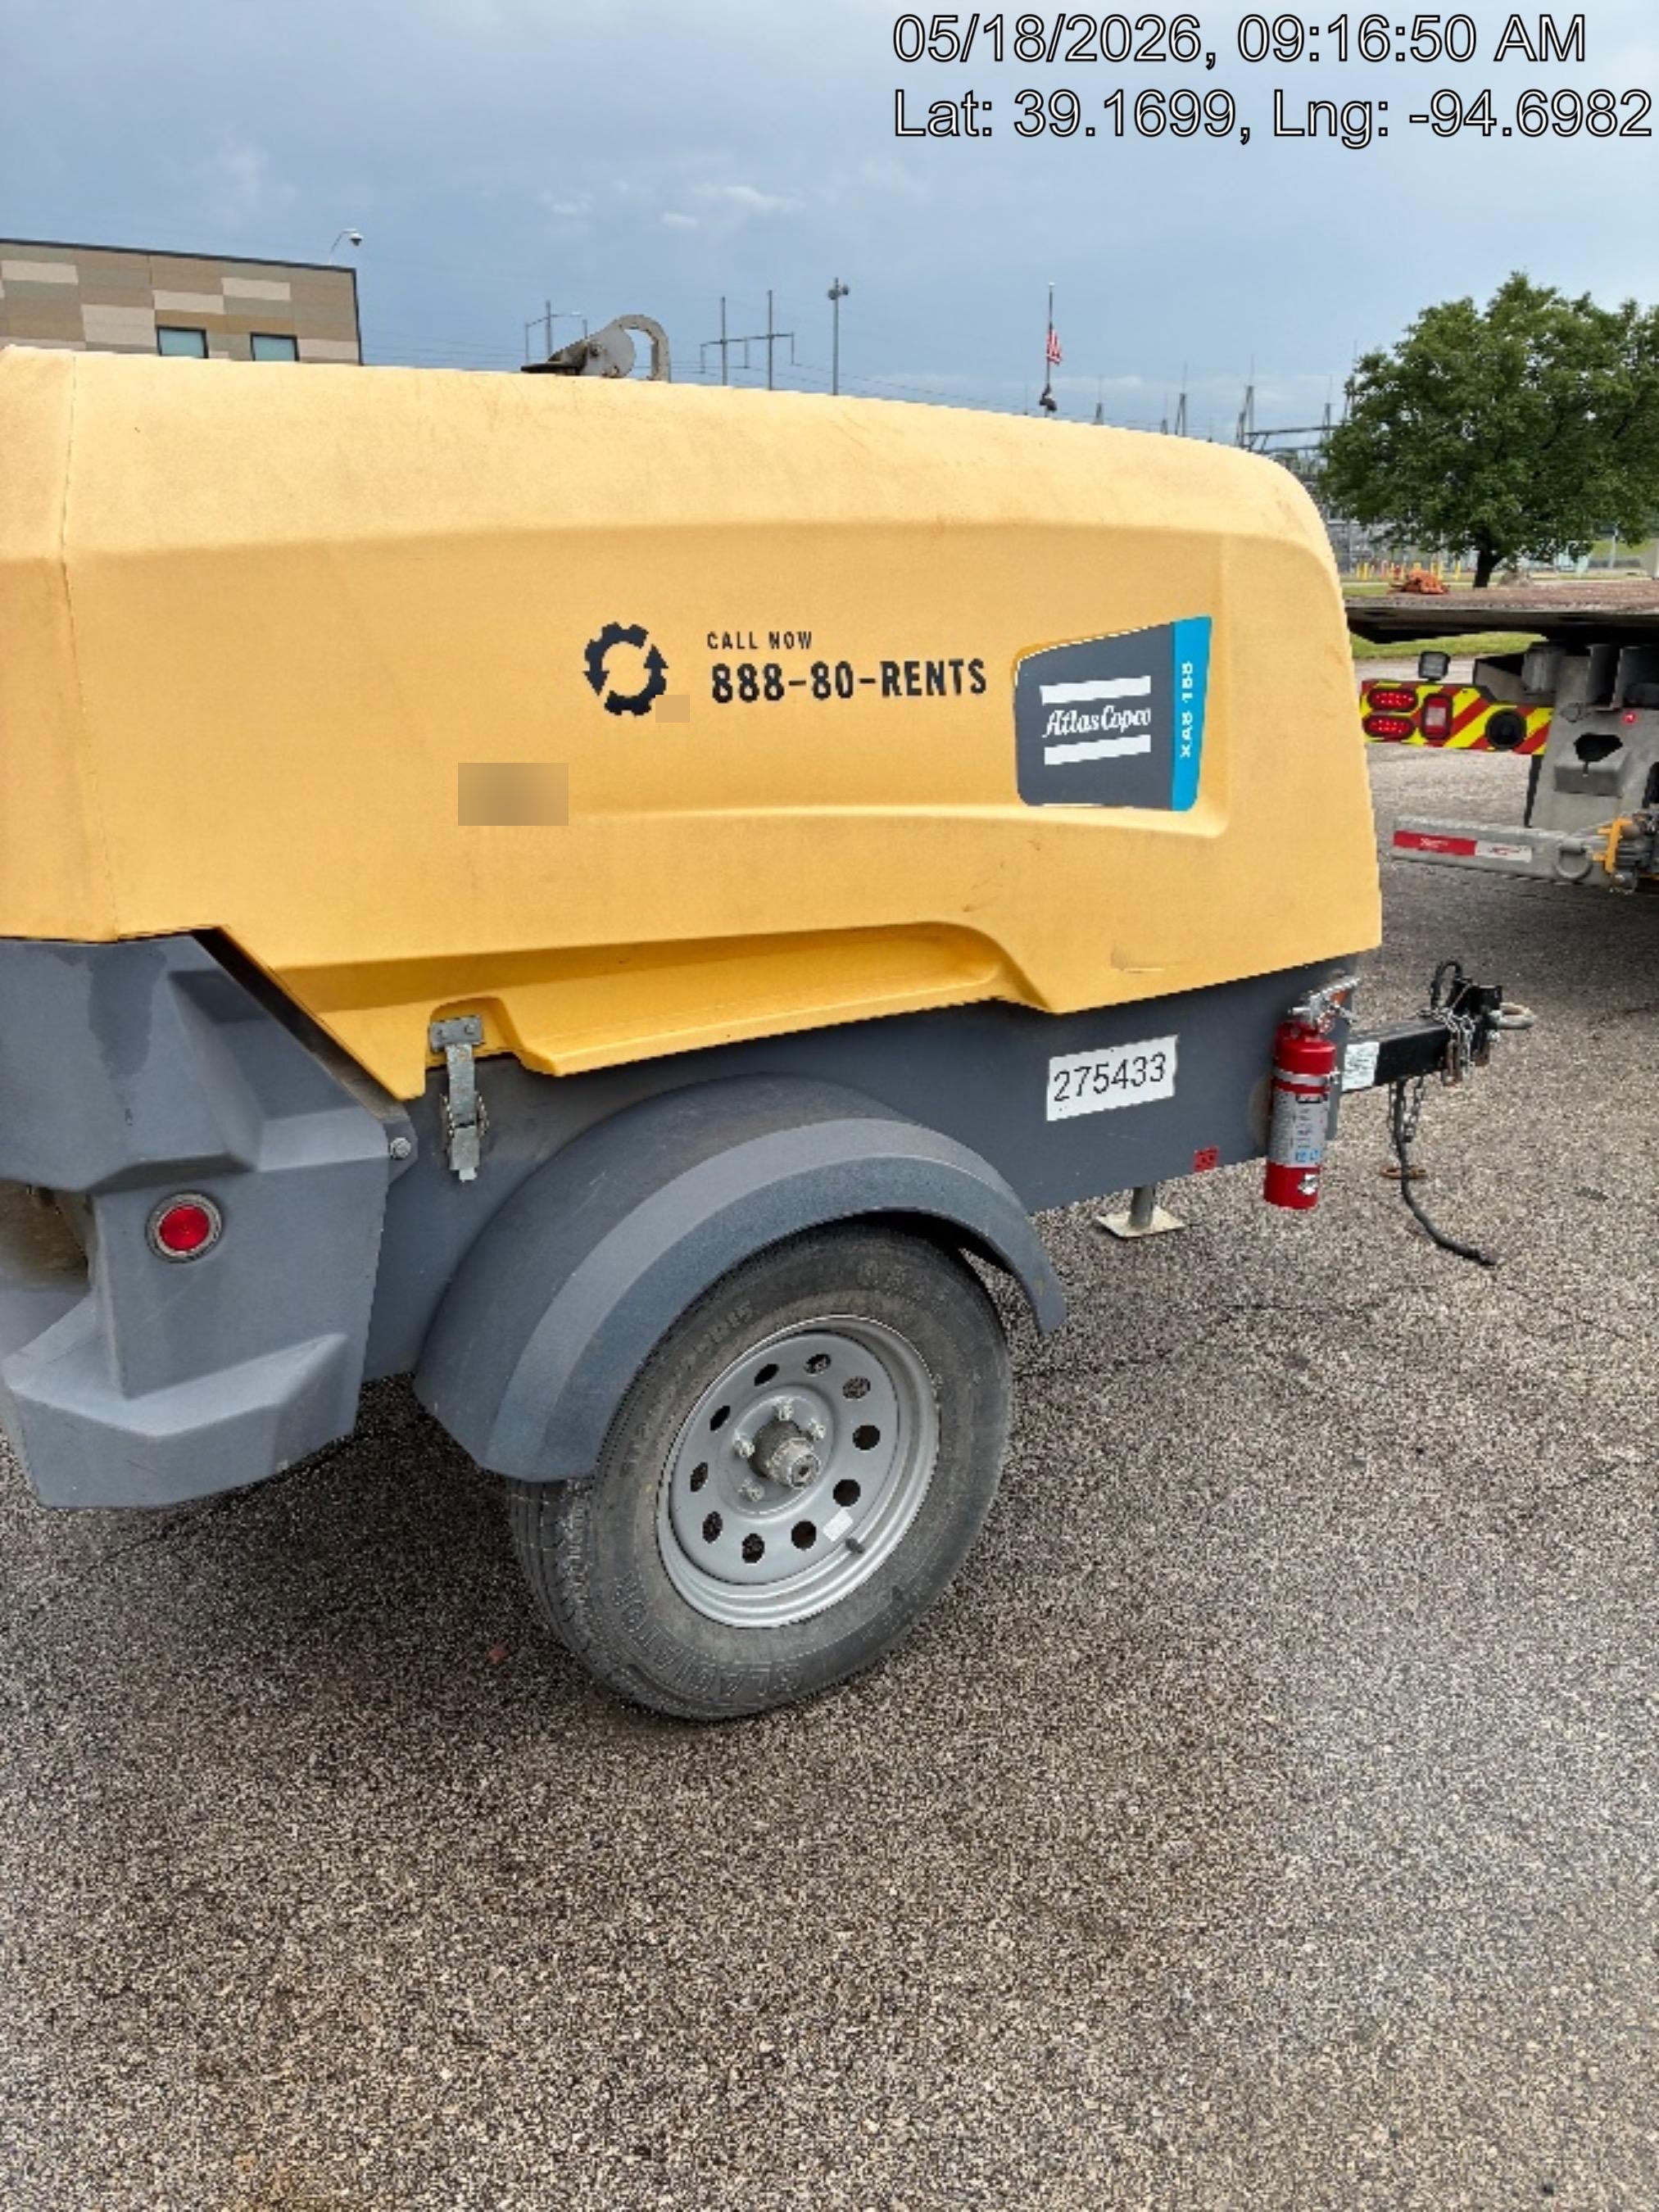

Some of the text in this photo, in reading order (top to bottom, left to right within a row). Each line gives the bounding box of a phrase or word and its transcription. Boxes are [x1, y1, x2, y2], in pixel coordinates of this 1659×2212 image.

[707, 630, 813, 650] CALL NOW
[711, 658, 987, 704] 888-80-RENTS
[1054, 1051, 1167, 1102] 275433
